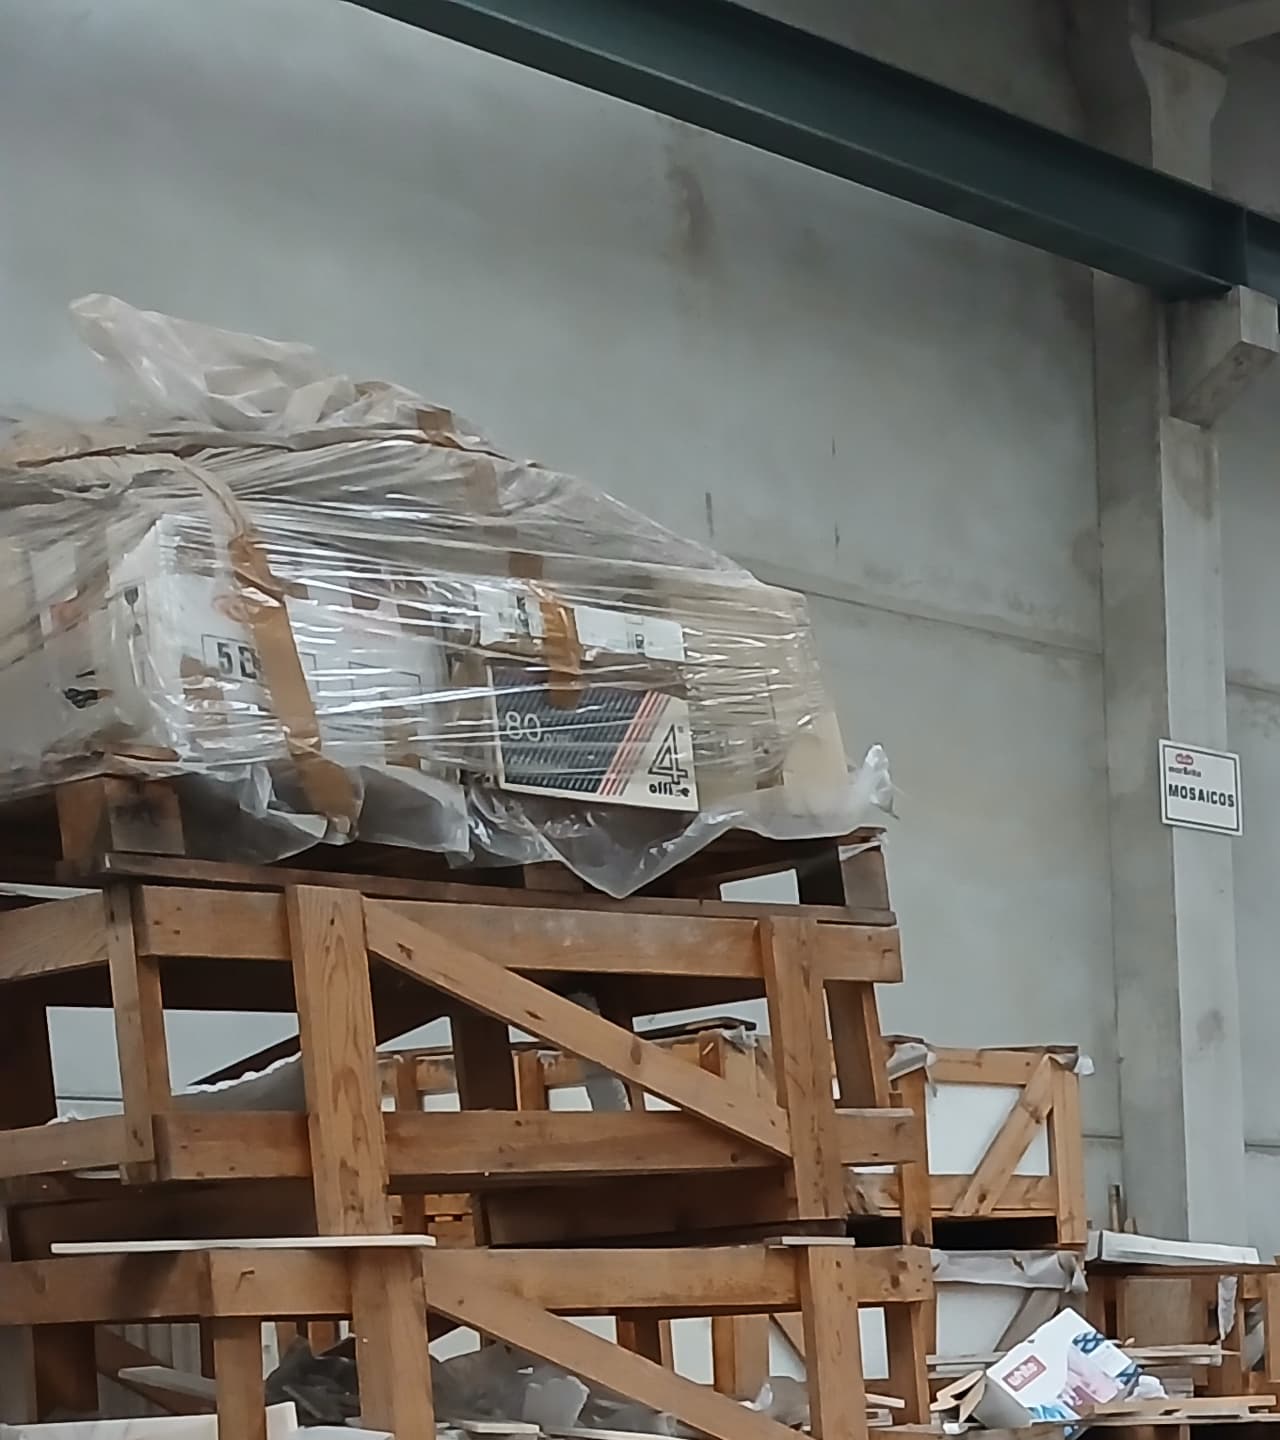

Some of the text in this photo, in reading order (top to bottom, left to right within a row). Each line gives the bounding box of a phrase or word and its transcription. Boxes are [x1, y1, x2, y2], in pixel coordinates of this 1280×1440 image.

[504, 711, 542, 742] 80
[648, 724, 689, 786] 4
[1168, 783, 1235, 808] MOSAICOS
